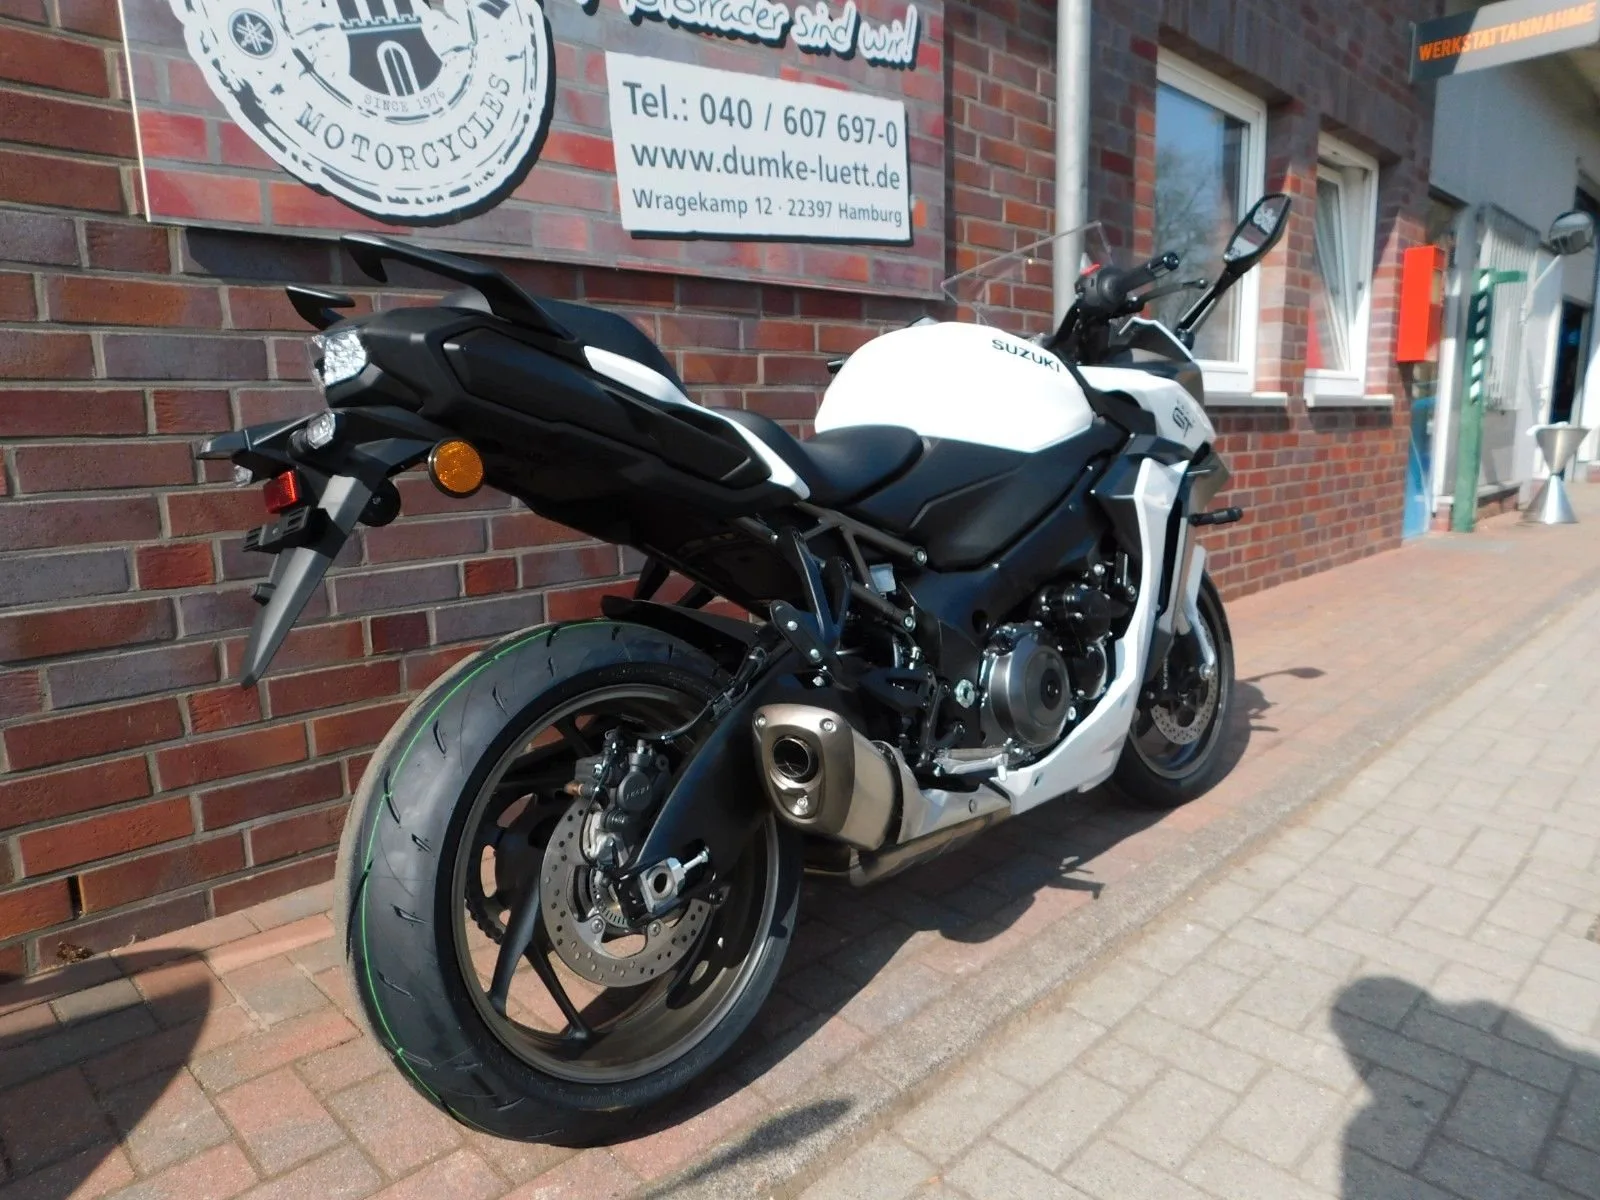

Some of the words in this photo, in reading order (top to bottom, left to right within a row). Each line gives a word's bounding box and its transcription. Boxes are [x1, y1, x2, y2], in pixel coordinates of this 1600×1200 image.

[796, 7, 852, 45] sind
[1418, 2, 1596, 61] WERKSTATTANNAHME
[363, 94, 409, 113] SINCE
[416, 88, 446, 110] 1976
[622, 80, 688, 121] Tel.:
[700, 93, 753, 129] 040
[764, 102, 772, 131] /
[783, 105, 826, 138] 607
[837, 113, 897, 148] 697-0
[295, 72, 510, 172] MOTORCYCLES
[631, 144, 900, 190] www.dumke-luett.de
[632, 188, 748, 218] Wragekamp
[755, 196, 773, 215] 12
[787, 199, 832, 218] 22397
[838, 202, 902, 227] Hamburg
[992, 340, 1060, 373] SUZUKI
